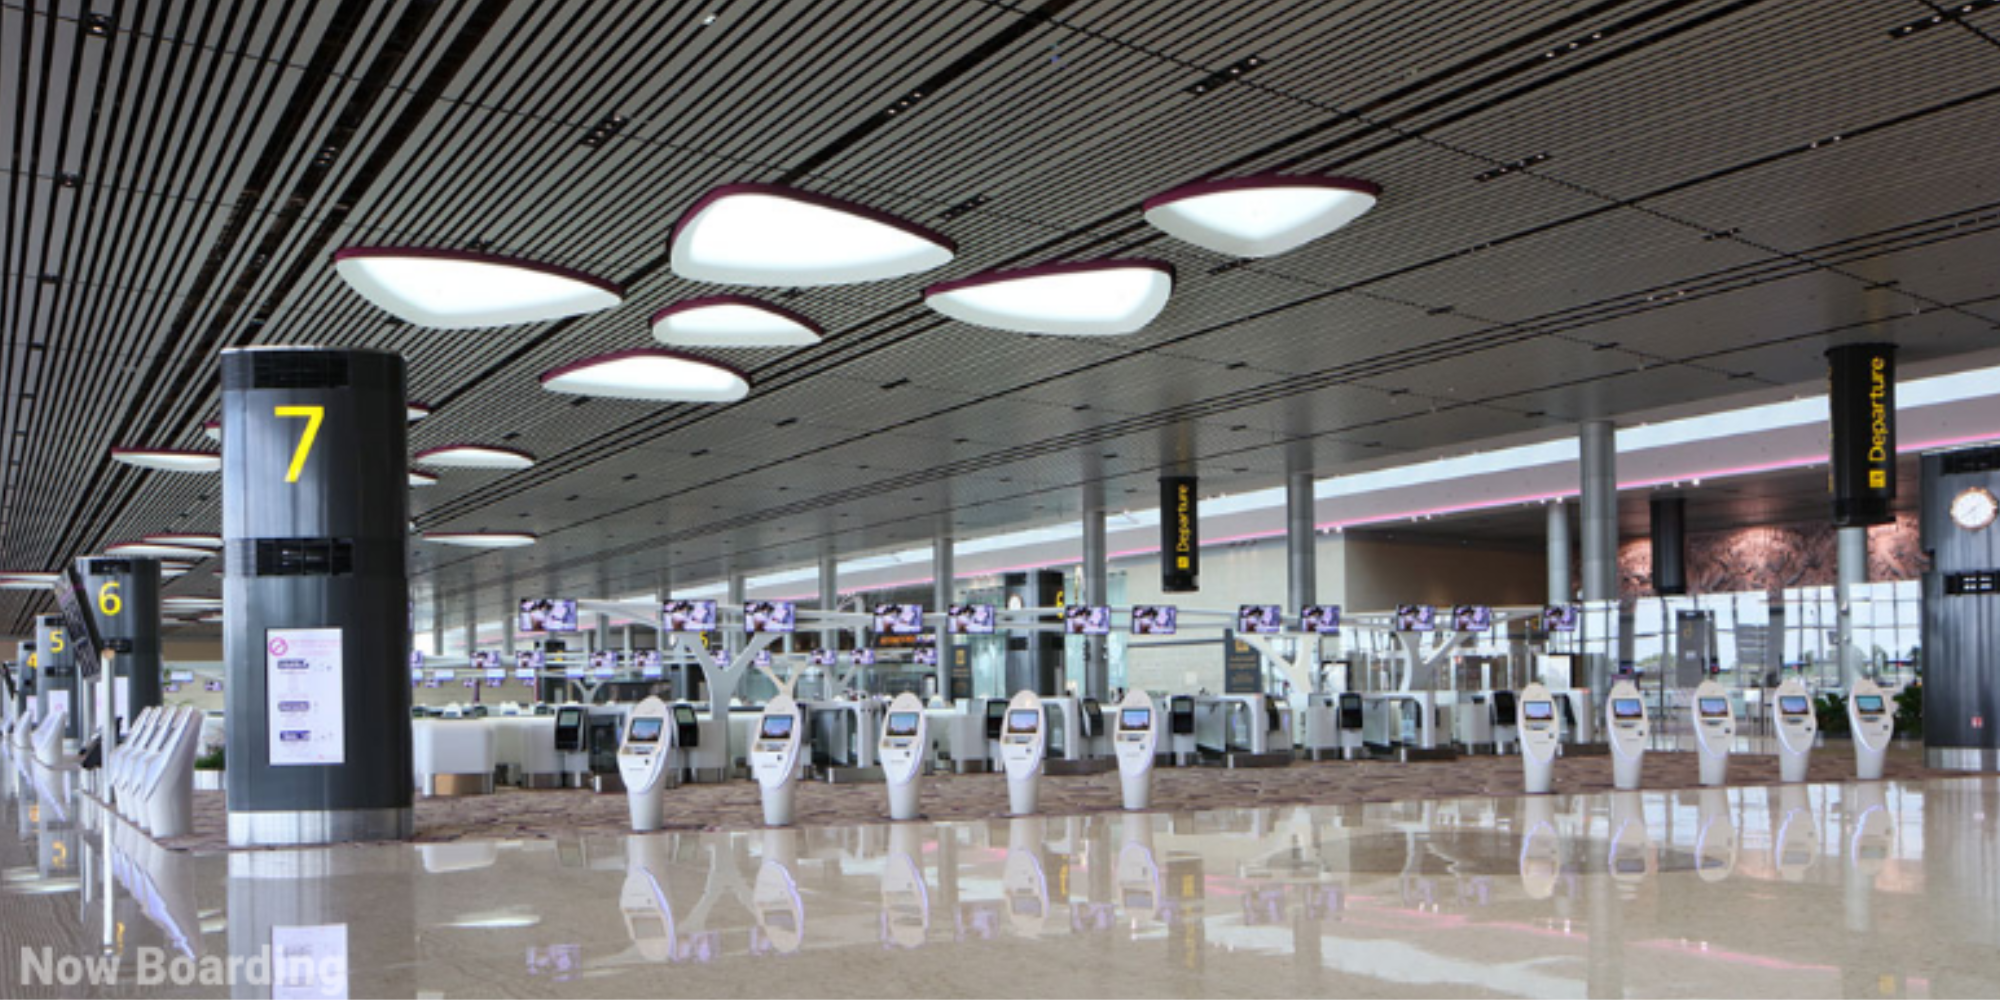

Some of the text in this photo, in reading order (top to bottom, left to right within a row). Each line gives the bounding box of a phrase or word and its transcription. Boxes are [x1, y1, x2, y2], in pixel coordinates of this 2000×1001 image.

[1868, 356, 1888, 461] Departure
[274, 405, 325, 482] 7
[1176, 484, 1191, 552] Departure
[98, 581, 121, 616] 6
[50, 630, 64, 653] 5
